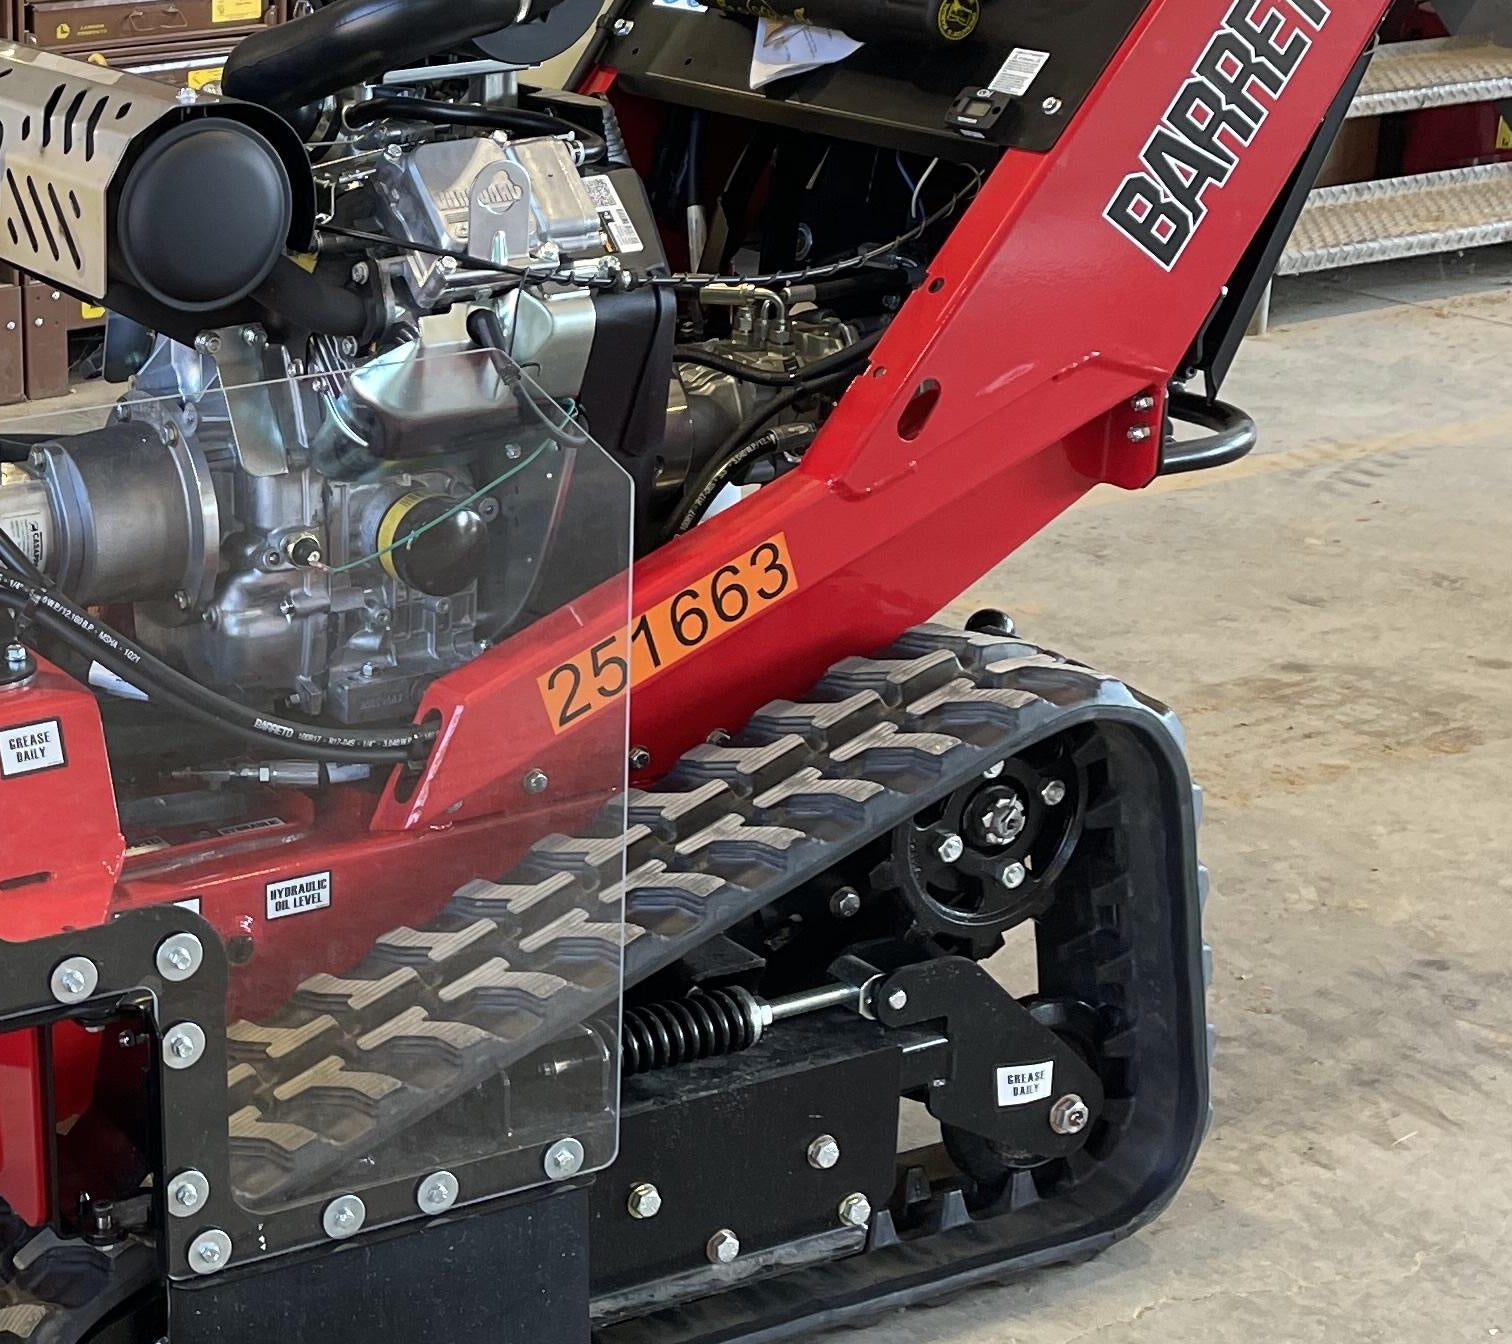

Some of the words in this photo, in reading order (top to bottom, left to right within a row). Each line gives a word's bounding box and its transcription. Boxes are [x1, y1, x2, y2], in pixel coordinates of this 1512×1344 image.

[547, 542, 789, 727] 251663
[253, 717, 294, 738] BARRETO
[8, 731, 50, 750] GREASE
[16, 747, 46, 763] DAILY
[270, 877, 327, 901] HYDRAULIC
[274, 896, 290, 912] OIL
[293, 892, 323, 908] LEVEL
[1007, 1070, 1045, 1084] GREASE
[1013, 1083, 1040, 1096] DAILY
